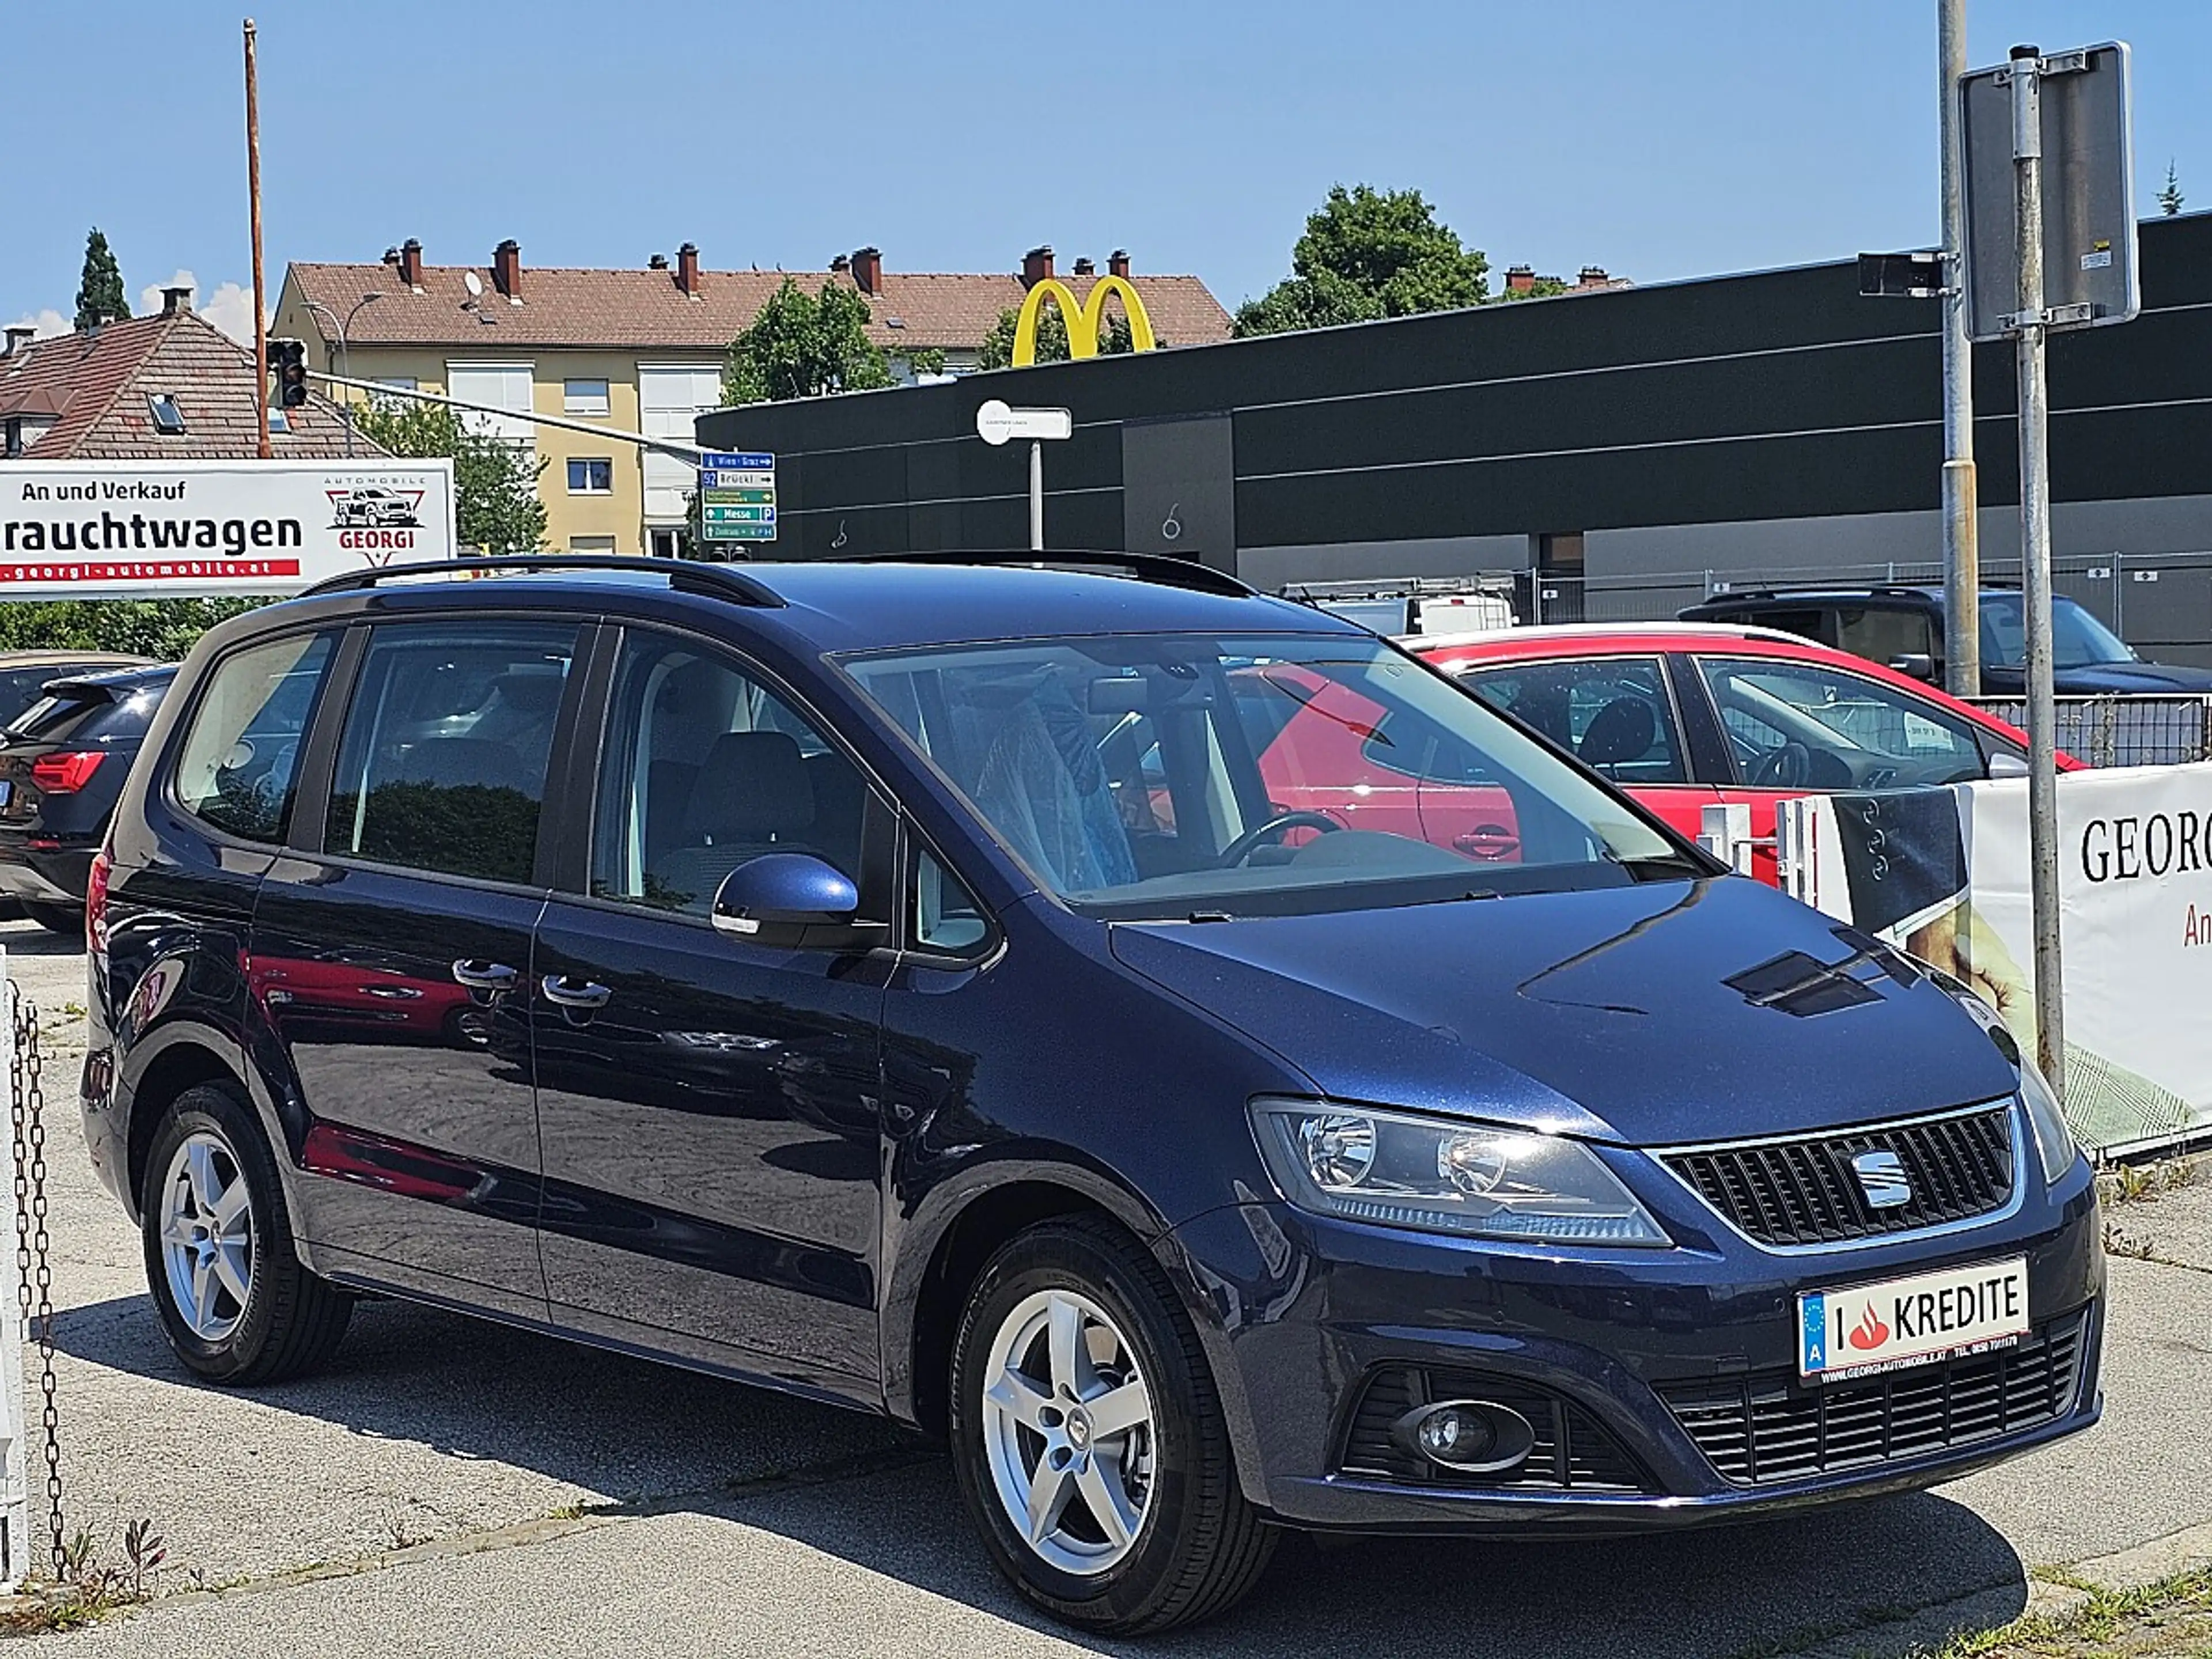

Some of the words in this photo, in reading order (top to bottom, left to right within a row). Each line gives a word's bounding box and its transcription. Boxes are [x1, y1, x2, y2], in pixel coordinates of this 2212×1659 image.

[22, 482, 50, 500] An
[56, 482, 97, 500] und
[101, 481, 187, 499] Verkauf
[339, 531, 414, 548] GEORGI
[2081, 810, 2212, 883] GEOR
[1895, 1275, 2019, 1341] KREDITE
[1809, 1343, 1822, 1362] A
